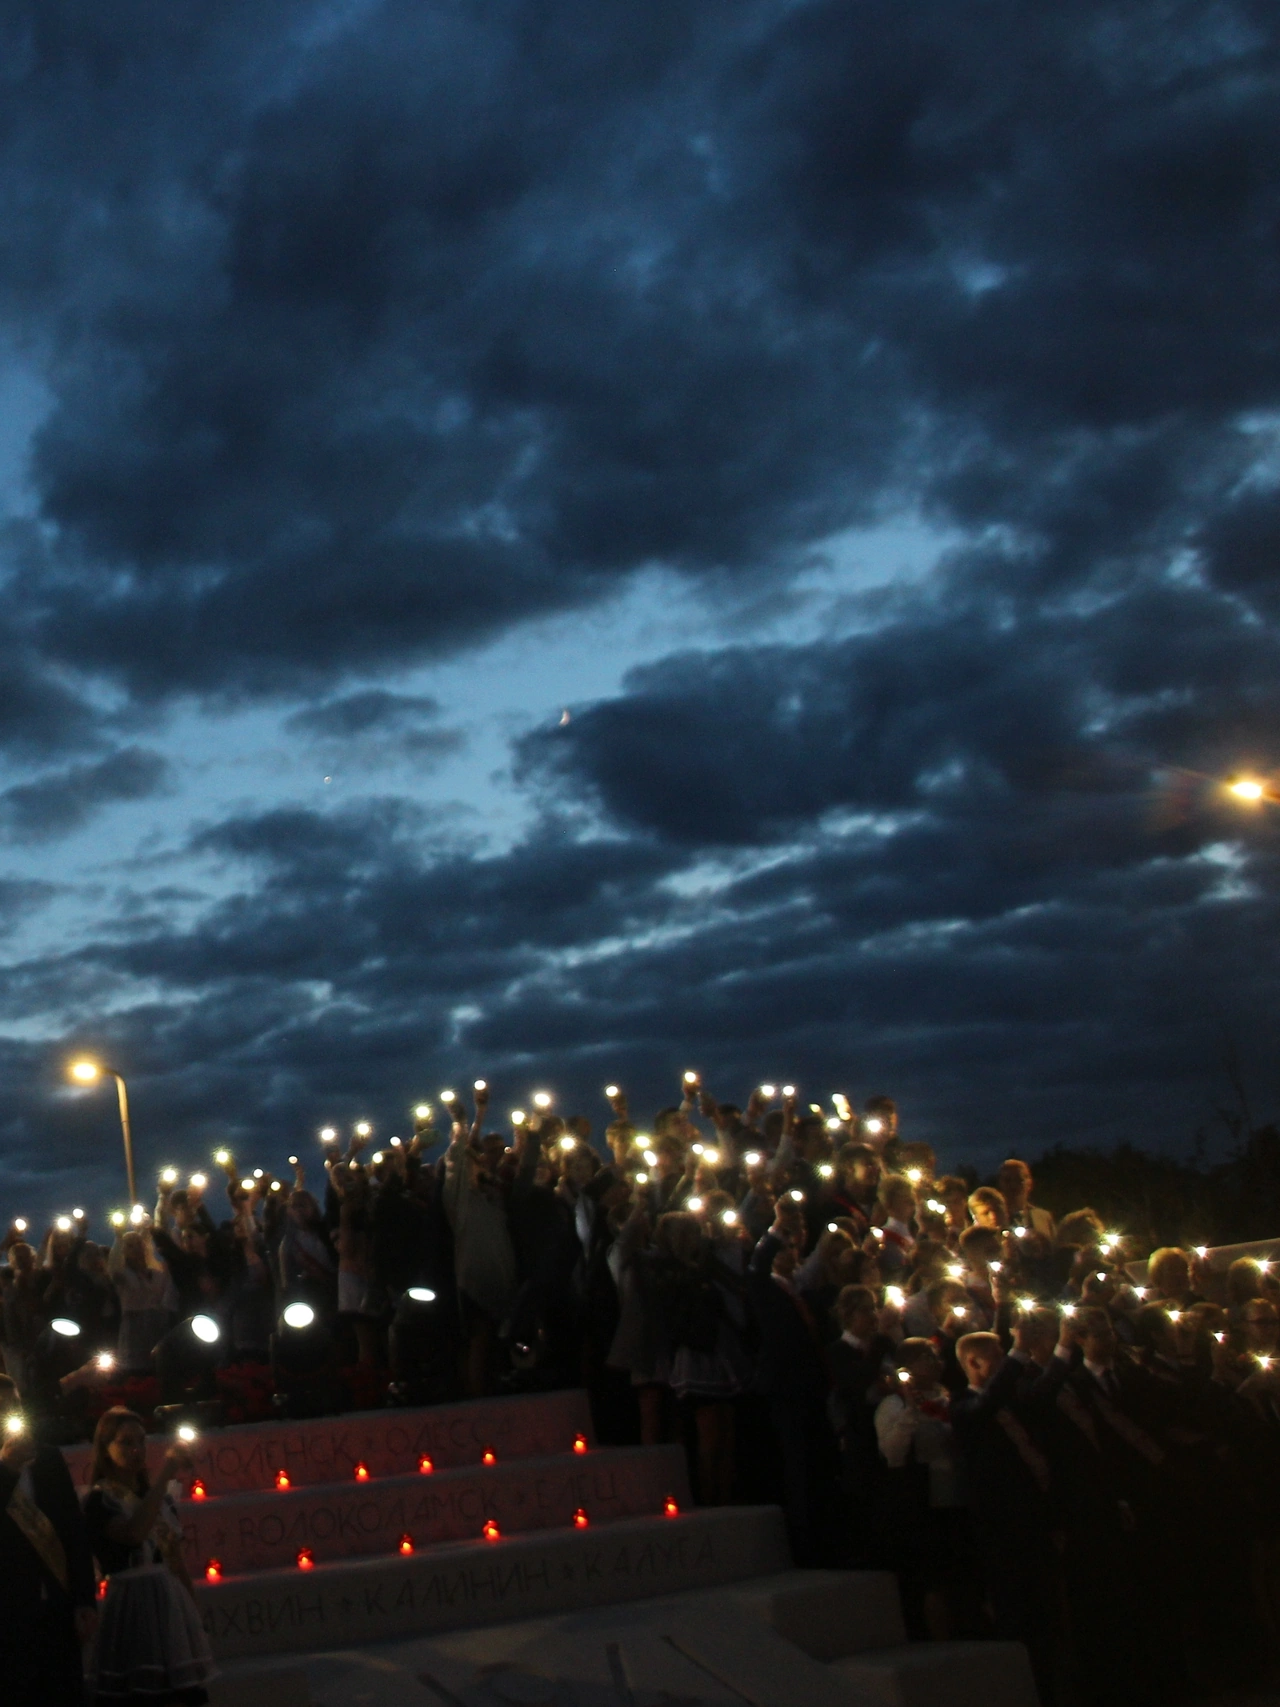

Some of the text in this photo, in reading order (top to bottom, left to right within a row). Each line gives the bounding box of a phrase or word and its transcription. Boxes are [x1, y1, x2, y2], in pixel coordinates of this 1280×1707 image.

[194, 1414, 513, 1477] МОЛЕНСК ОДЕССА
[239, 1487, 499, 1547] ВОЛОКОЛАМСК
[535, 1472, 618, 1510] ЕЛЕЦ
[202, 1534, 716, 1637] ИХВИН КАЛИНИН КАЛУГА
